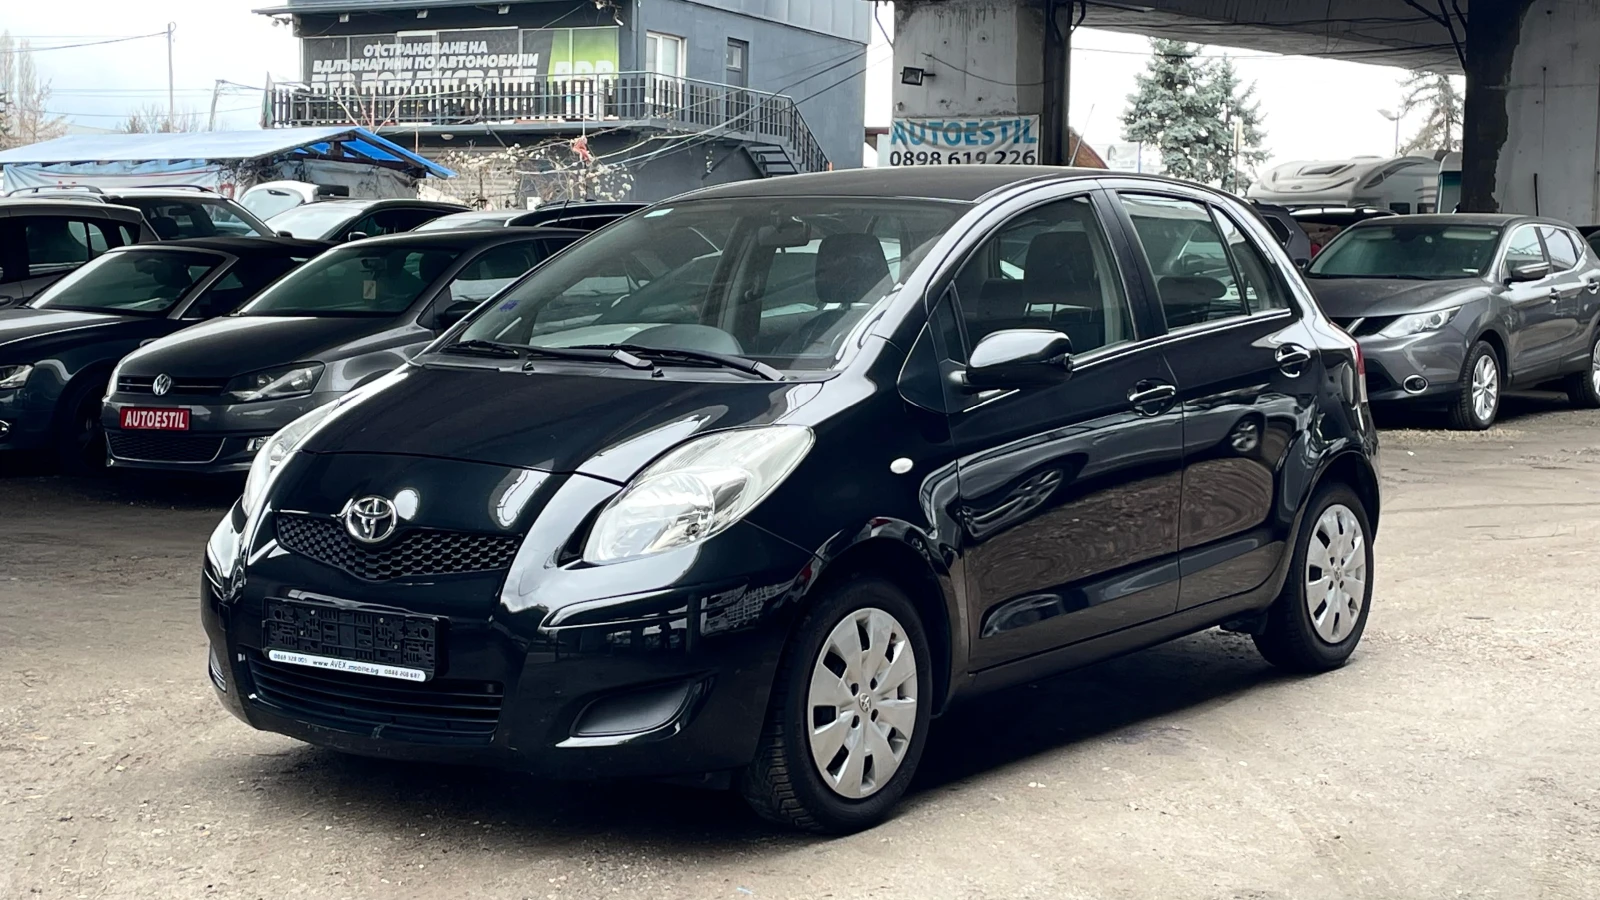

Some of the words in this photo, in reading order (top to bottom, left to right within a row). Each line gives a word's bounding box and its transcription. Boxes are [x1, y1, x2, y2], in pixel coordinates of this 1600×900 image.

[363, 41, 468, 57] ОТСТРАНЯВАНЕ
[468, 41, 488, 54] НА
[313, 56, 413, 73] ВДЛЪБНАТИНИ
[414, 56, 436, 69] ПО
[437, 53, 539, 68] АВТОМОБИЛИ
[891, 118, 1037, 146] AUTOESTIL
[889, 151, 942, 166] 0898
[948, 151, 988, 166] 619
[994, 150, 1036, 166] 226
[124, 410, 186, 428] AUTOESTIL
